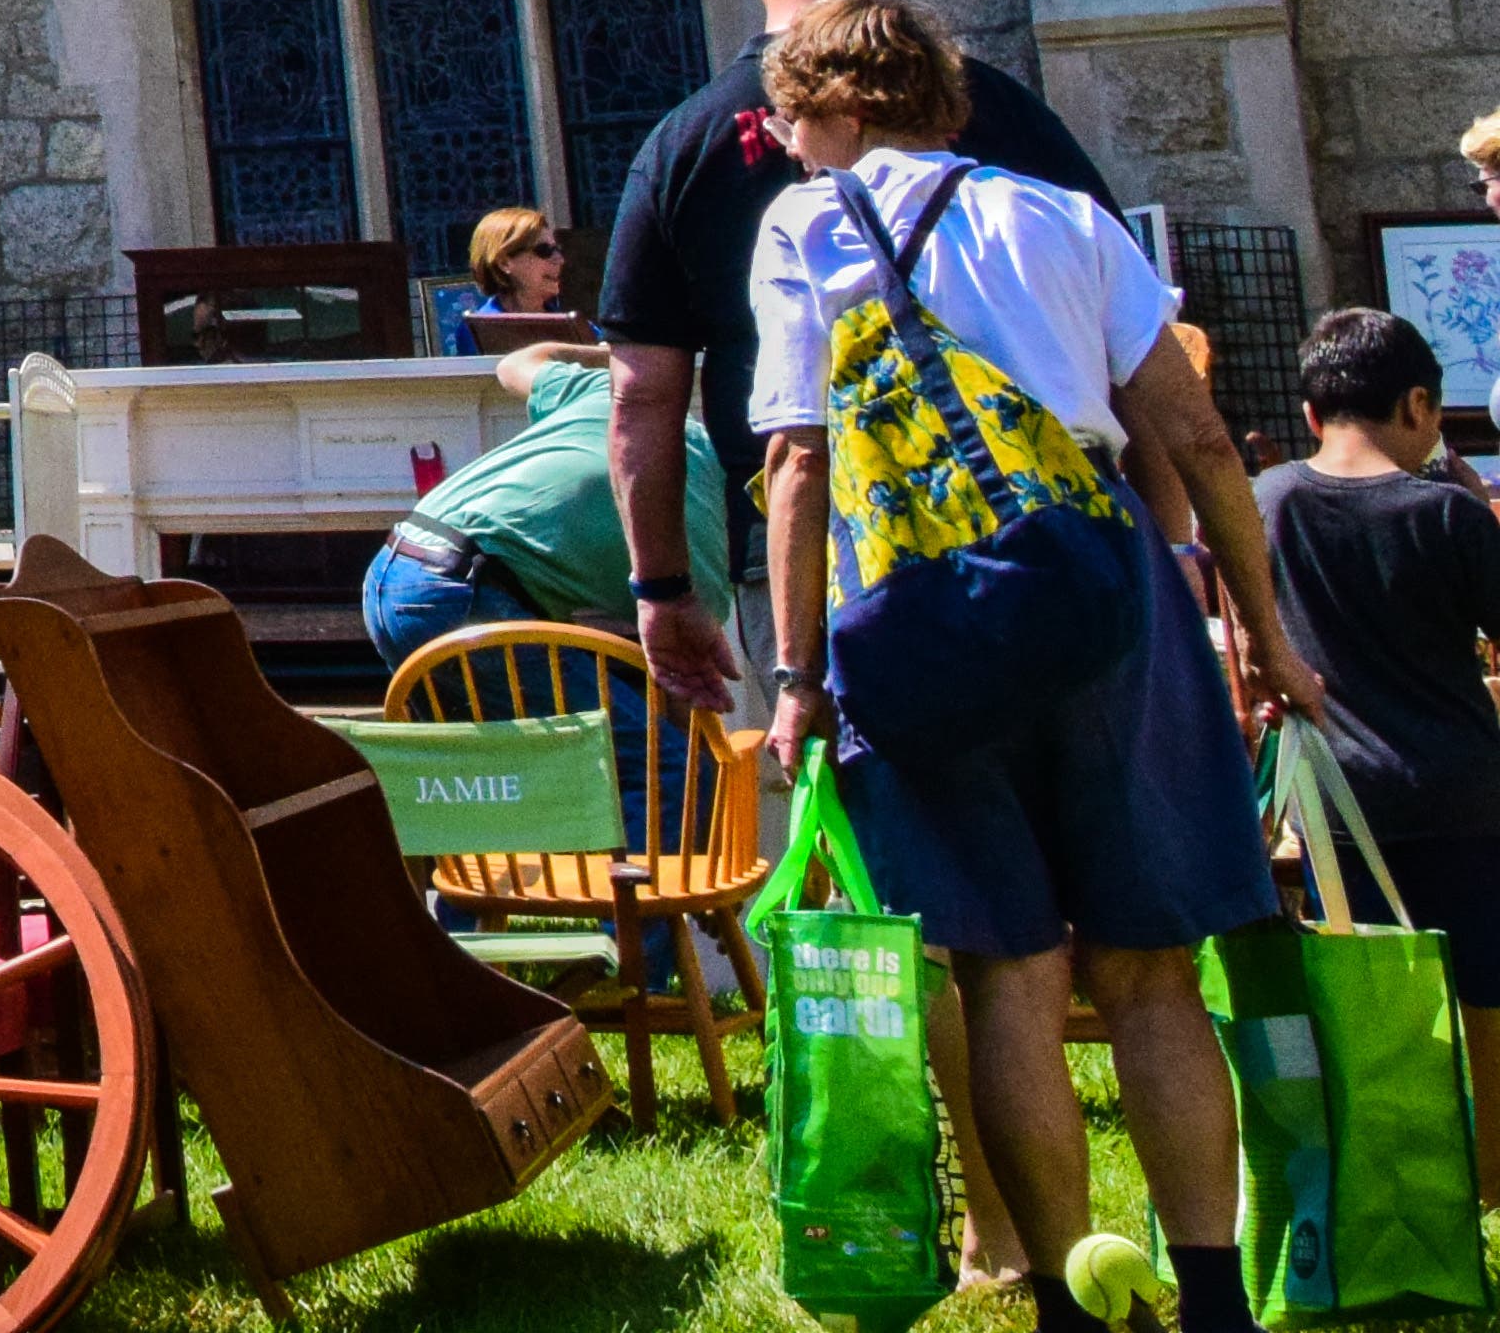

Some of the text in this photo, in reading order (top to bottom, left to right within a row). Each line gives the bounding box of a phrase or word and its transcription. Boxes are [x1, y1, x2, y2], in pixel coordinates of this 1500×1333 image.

[415, 774, 522, 803] JAMIE
[792, 943, 900, 974] there is
[793, 970, 901, 997] only one
[795, 994, 904, 1038] earth
